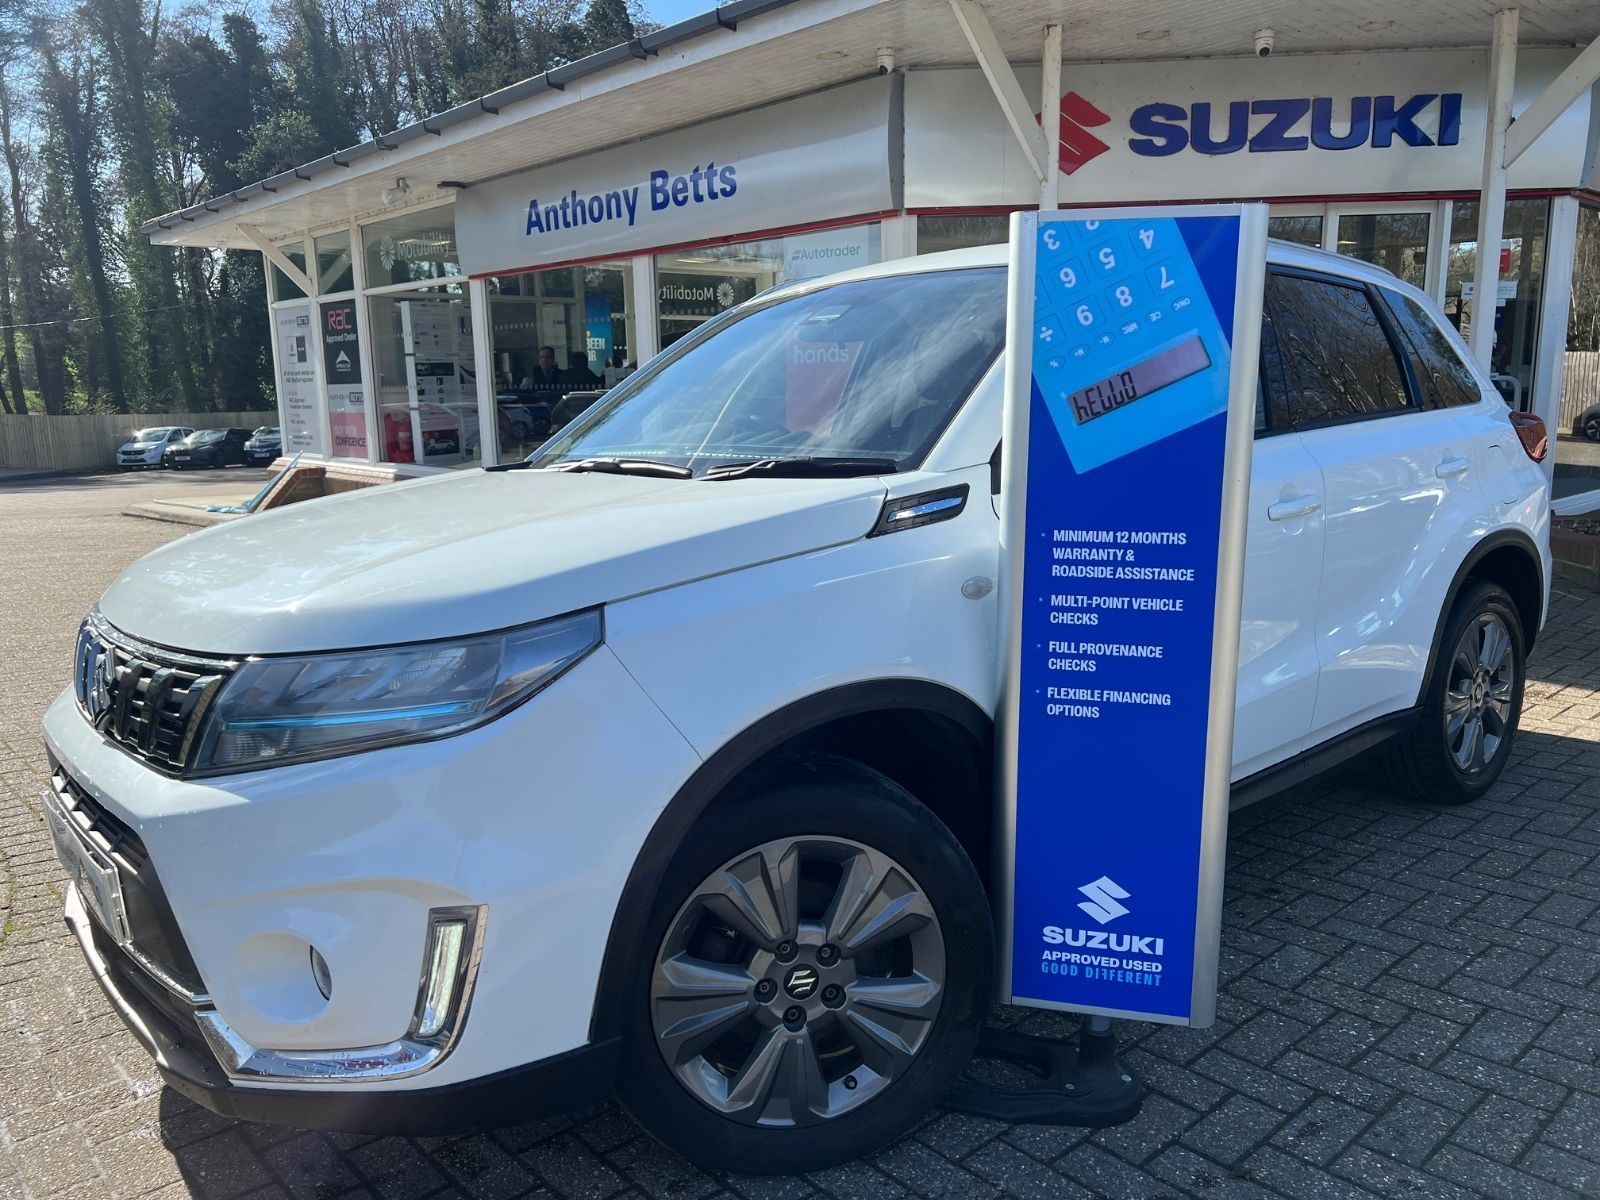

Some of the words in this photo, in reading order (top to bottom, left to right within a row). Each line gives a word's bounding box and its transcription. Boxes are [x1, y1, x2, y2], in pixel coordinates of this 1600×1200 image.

[1128, 93, 1463, 157] SUZUKI
[526, 187, 639, 236] Anthony
[650, 162, 737, 211] Betts
[1043, 229, 1060, 250] 3
[1139, 229, 1154, 250] 4
[801, 245, 861, 260] Autotrader
[1098, 247, 1116, 270] 5
[1160, 266, 1175, 290] 7
[1115, 286, 1133, 307] 8
[794, 343, 848, 364] hands
[1053, 529, 1114, 543] MINIMUM
[1115, 531, 1129, 544] 12
[1130, 532, 1187, 545] MONTHS
[1052, 547, 1124, 561] WARRANTY
[1125, 549, 1135, 561] &
[1052, 565, 1114, 579] ROADSIDE
[1115, 567, 1195, 581] ASSISTANCE
[1050, 594, 1130, 609] MULTI-POINT
[1132, 597, 1184, 611] VEHICLE
[1050, 611, 1099, 625] CHECKS
[1049, 641, 1078, 654] FULL
[1079, 642, 1164, 658] PROVENANCE
[1048, 658, 1097, 672] CHECKS
[1047, 686, 1102, 702] FLEXIBLE
[1103, 690, 1172, 706] FINANCING
[1047, 703, 1100, 718] OPTIONS
[1042, 925, 1164, 956] SUZUKI
[1042, 950, 1120, 968] APPROVED
[1122, 959, 1162, 973] USED
[1041, 962, 1078, 977] GOOD
[1085, 966, 1162, 986] DIFFERENT
